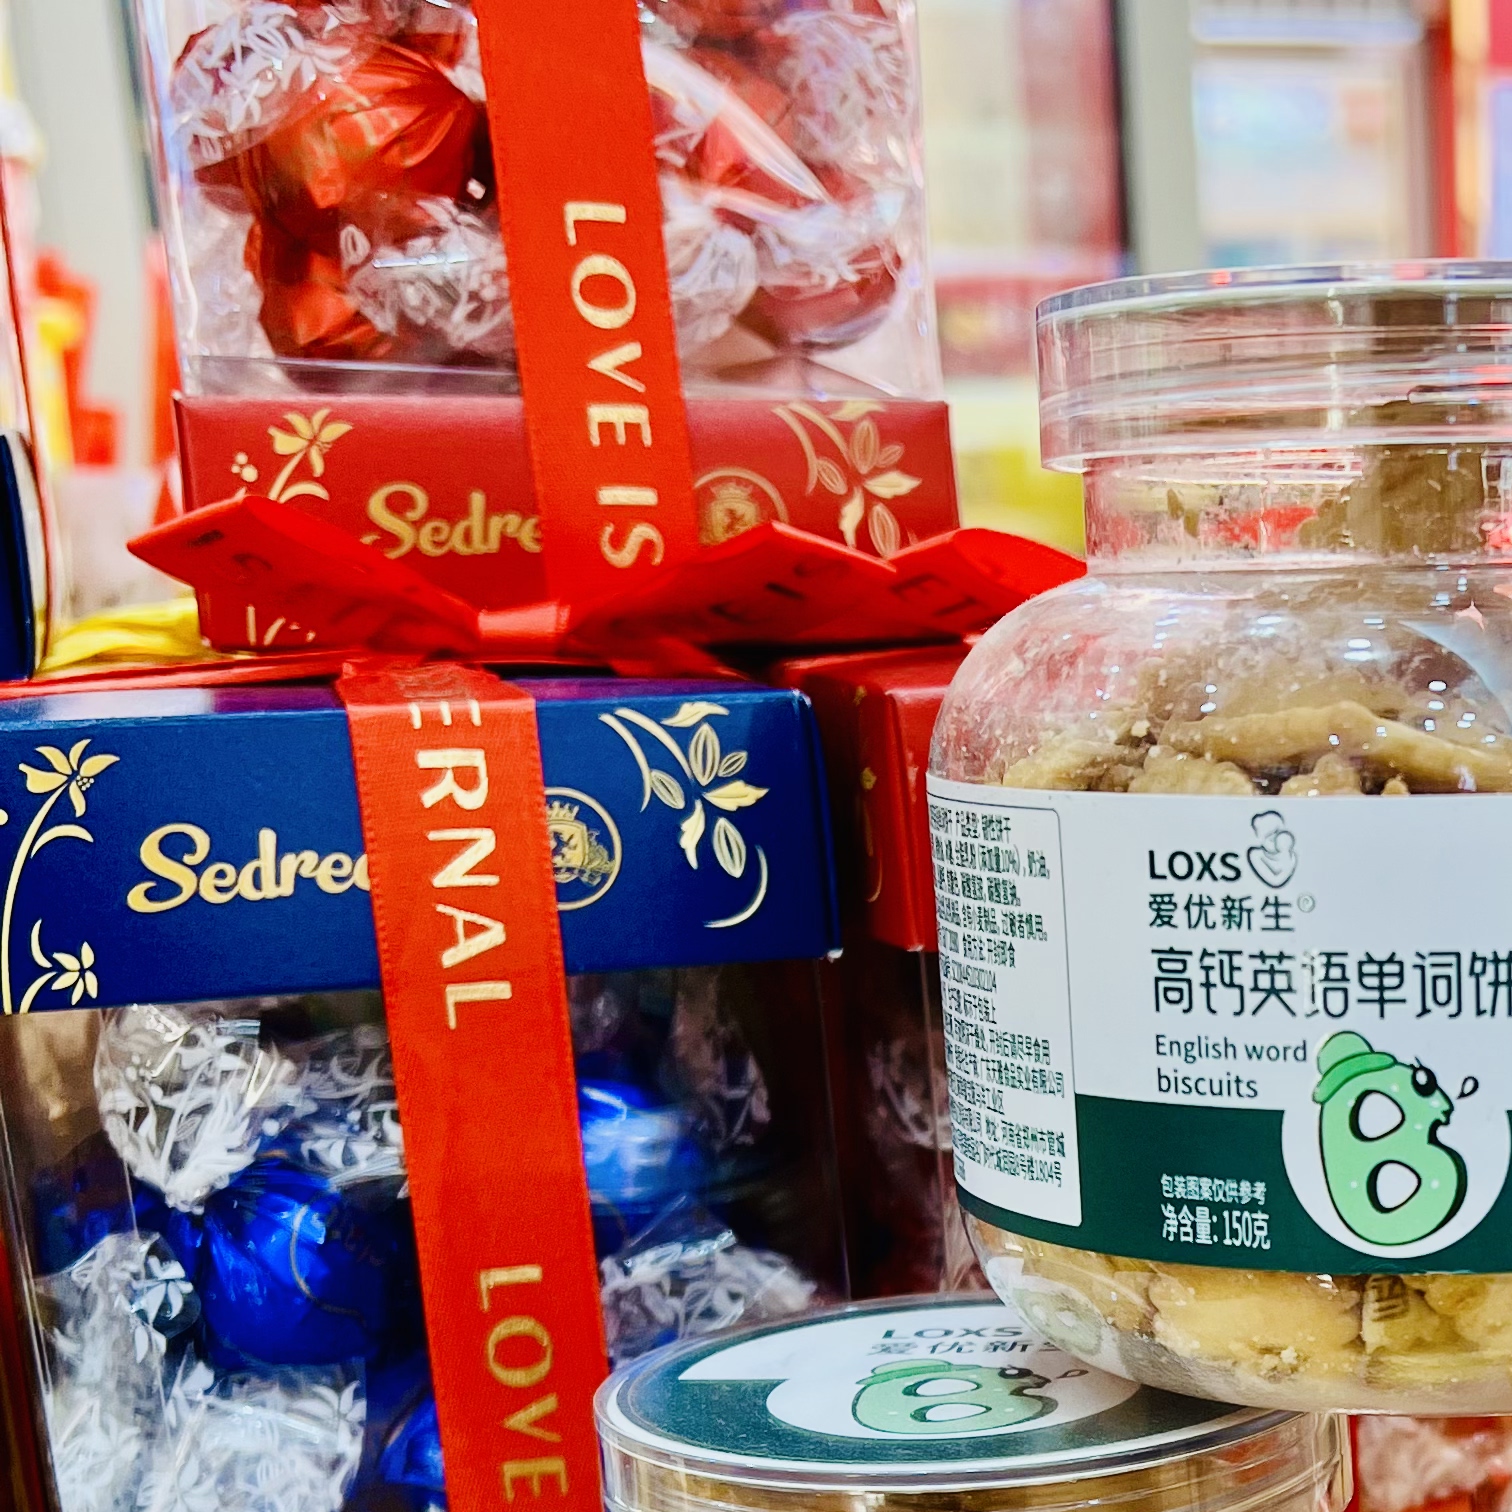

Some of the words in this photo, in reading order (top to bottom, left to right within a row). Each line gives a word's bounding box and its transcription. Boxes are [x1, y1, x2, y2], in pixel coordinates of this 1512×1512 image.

[563, 201, 654, 449] LOVE
[595, 484, 666, 569] IS
[1147, 850, 1242, 882] LOXS
[1154, 1033, 1238, 1065] English
[1243, 1037, 1308, 1064] word
[1156, 1066, 1260, 1100] biscuits
[1160, 1173, 1267, 1206] 包装图案仅供参考
[882, 1326, 1024, 1340] LOXS
[476, 1262, 570, 1505] LOVE
